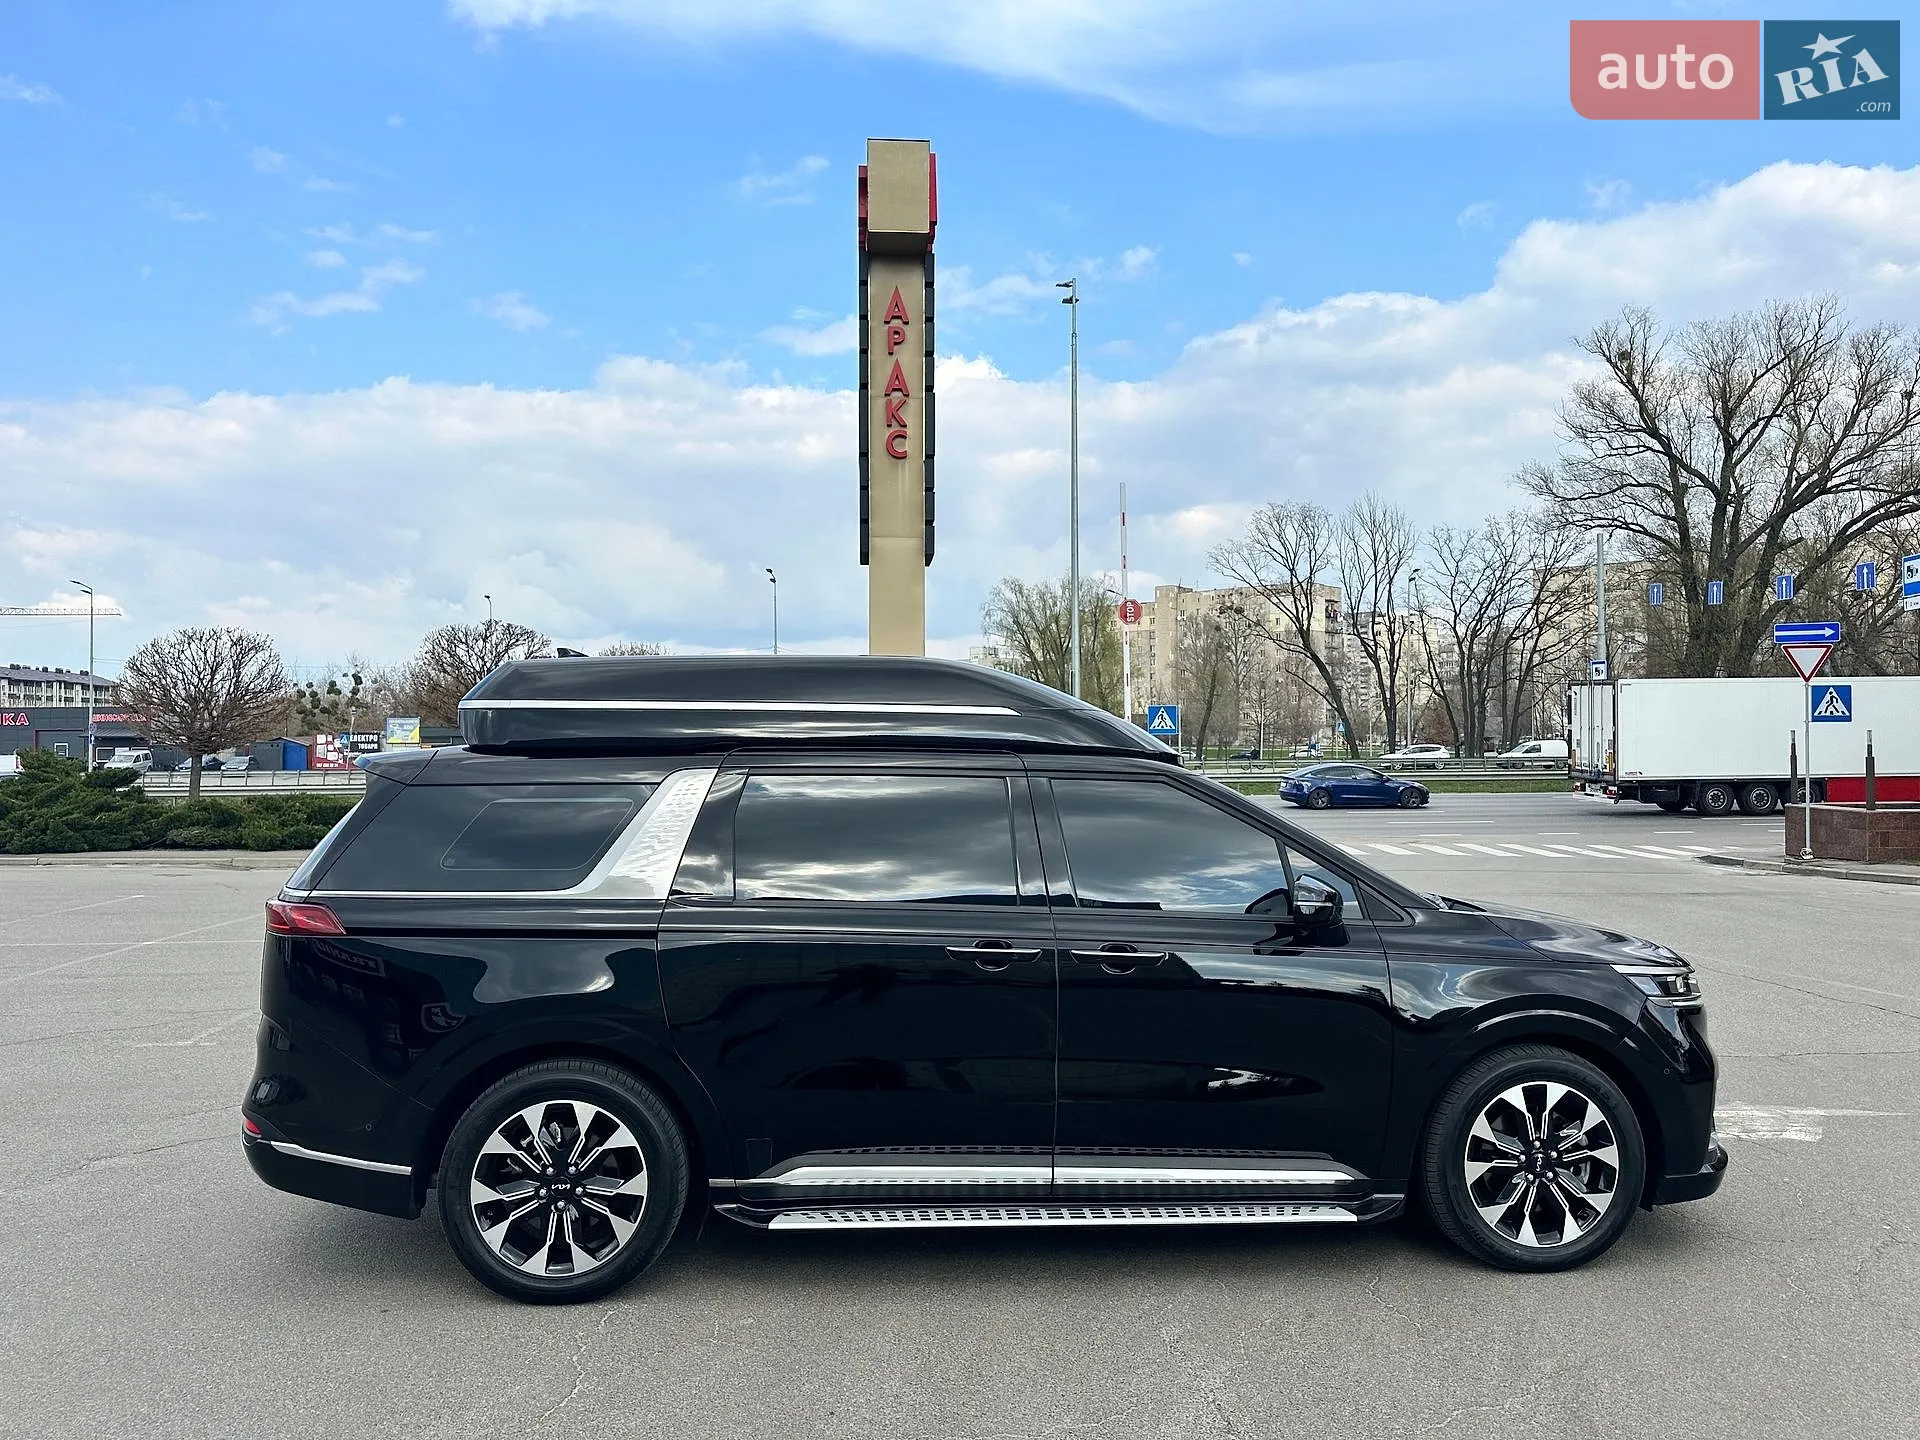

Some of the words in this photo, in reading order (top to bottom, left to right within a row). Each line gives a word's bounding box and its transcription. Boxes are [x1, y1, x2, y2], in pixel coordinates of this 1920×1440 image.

[884, 285, 910, 459] АРАКС
[1126, 601, 1135, 622] STOP
[0, 712, 30, 726] КА
[350, 734, 378, 742] ЕЛЕКТРО
